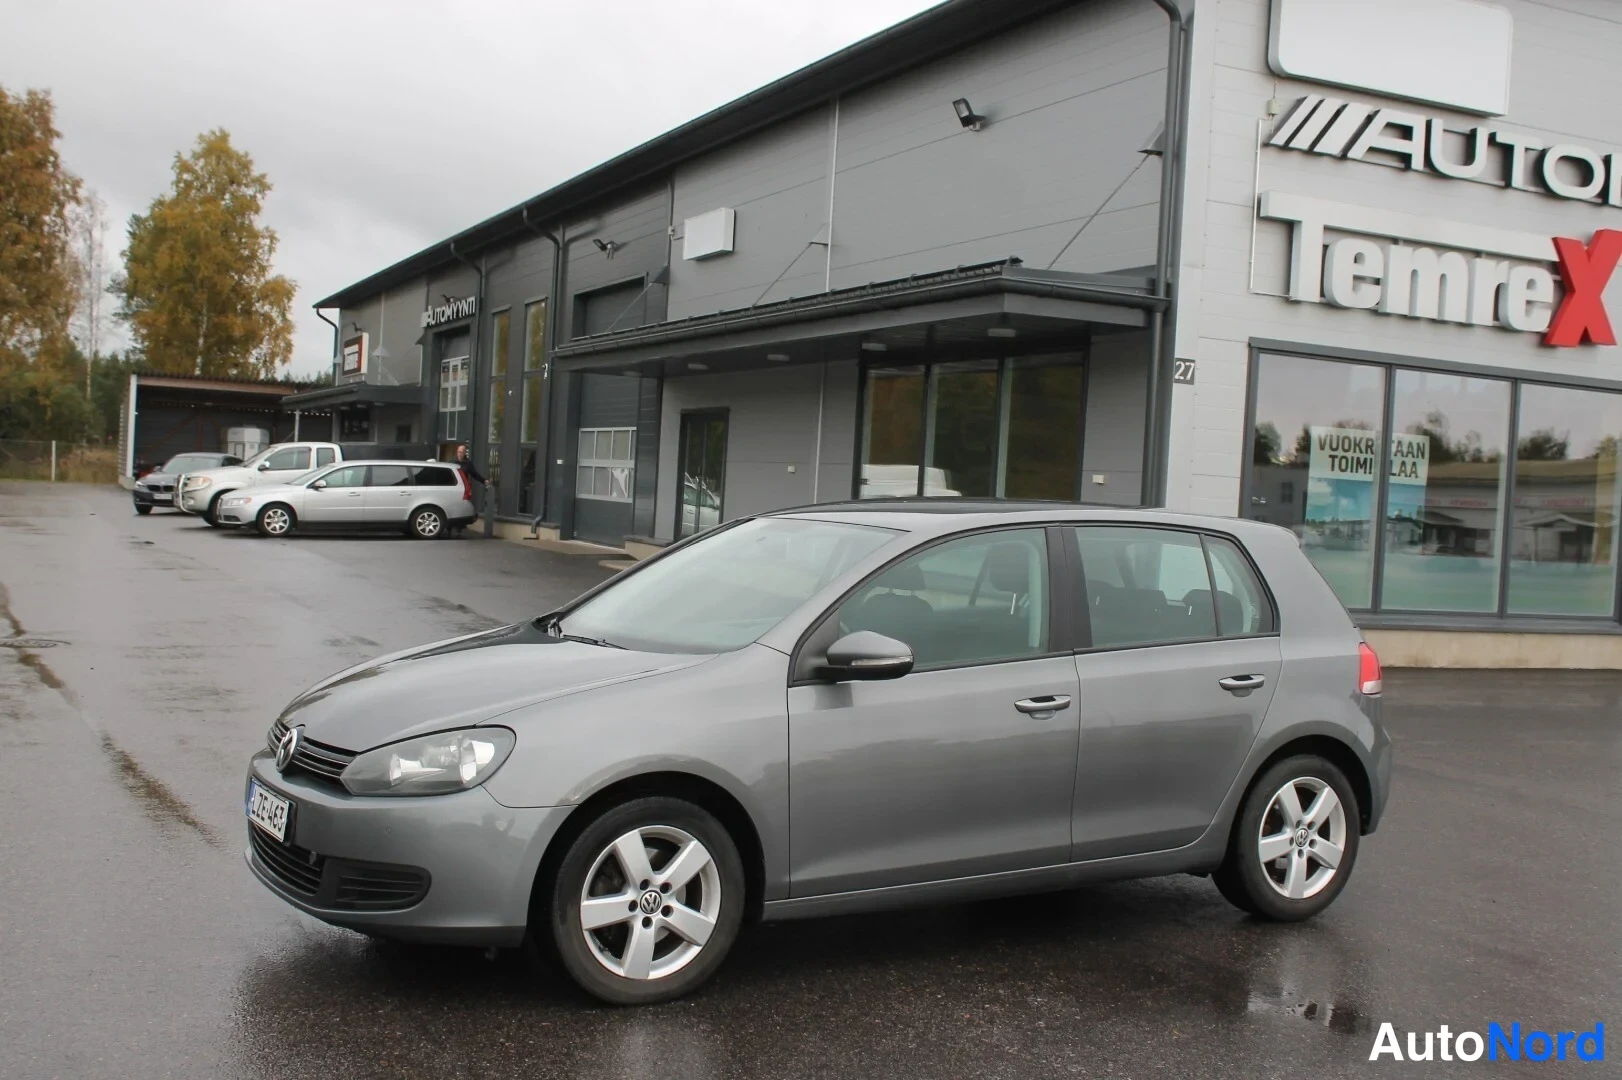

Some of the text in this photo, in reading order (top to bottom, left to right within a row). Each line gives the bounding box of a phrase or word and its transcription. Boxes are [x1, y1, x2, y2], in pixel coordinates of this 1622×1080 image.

[1259, 190, 1622, 347] TemreX
[1174, 360, 1195, 381] 27
[1317, 433, 1426, 460] VUOKRAAN
[251, 788, 286, 832] LZE-463
